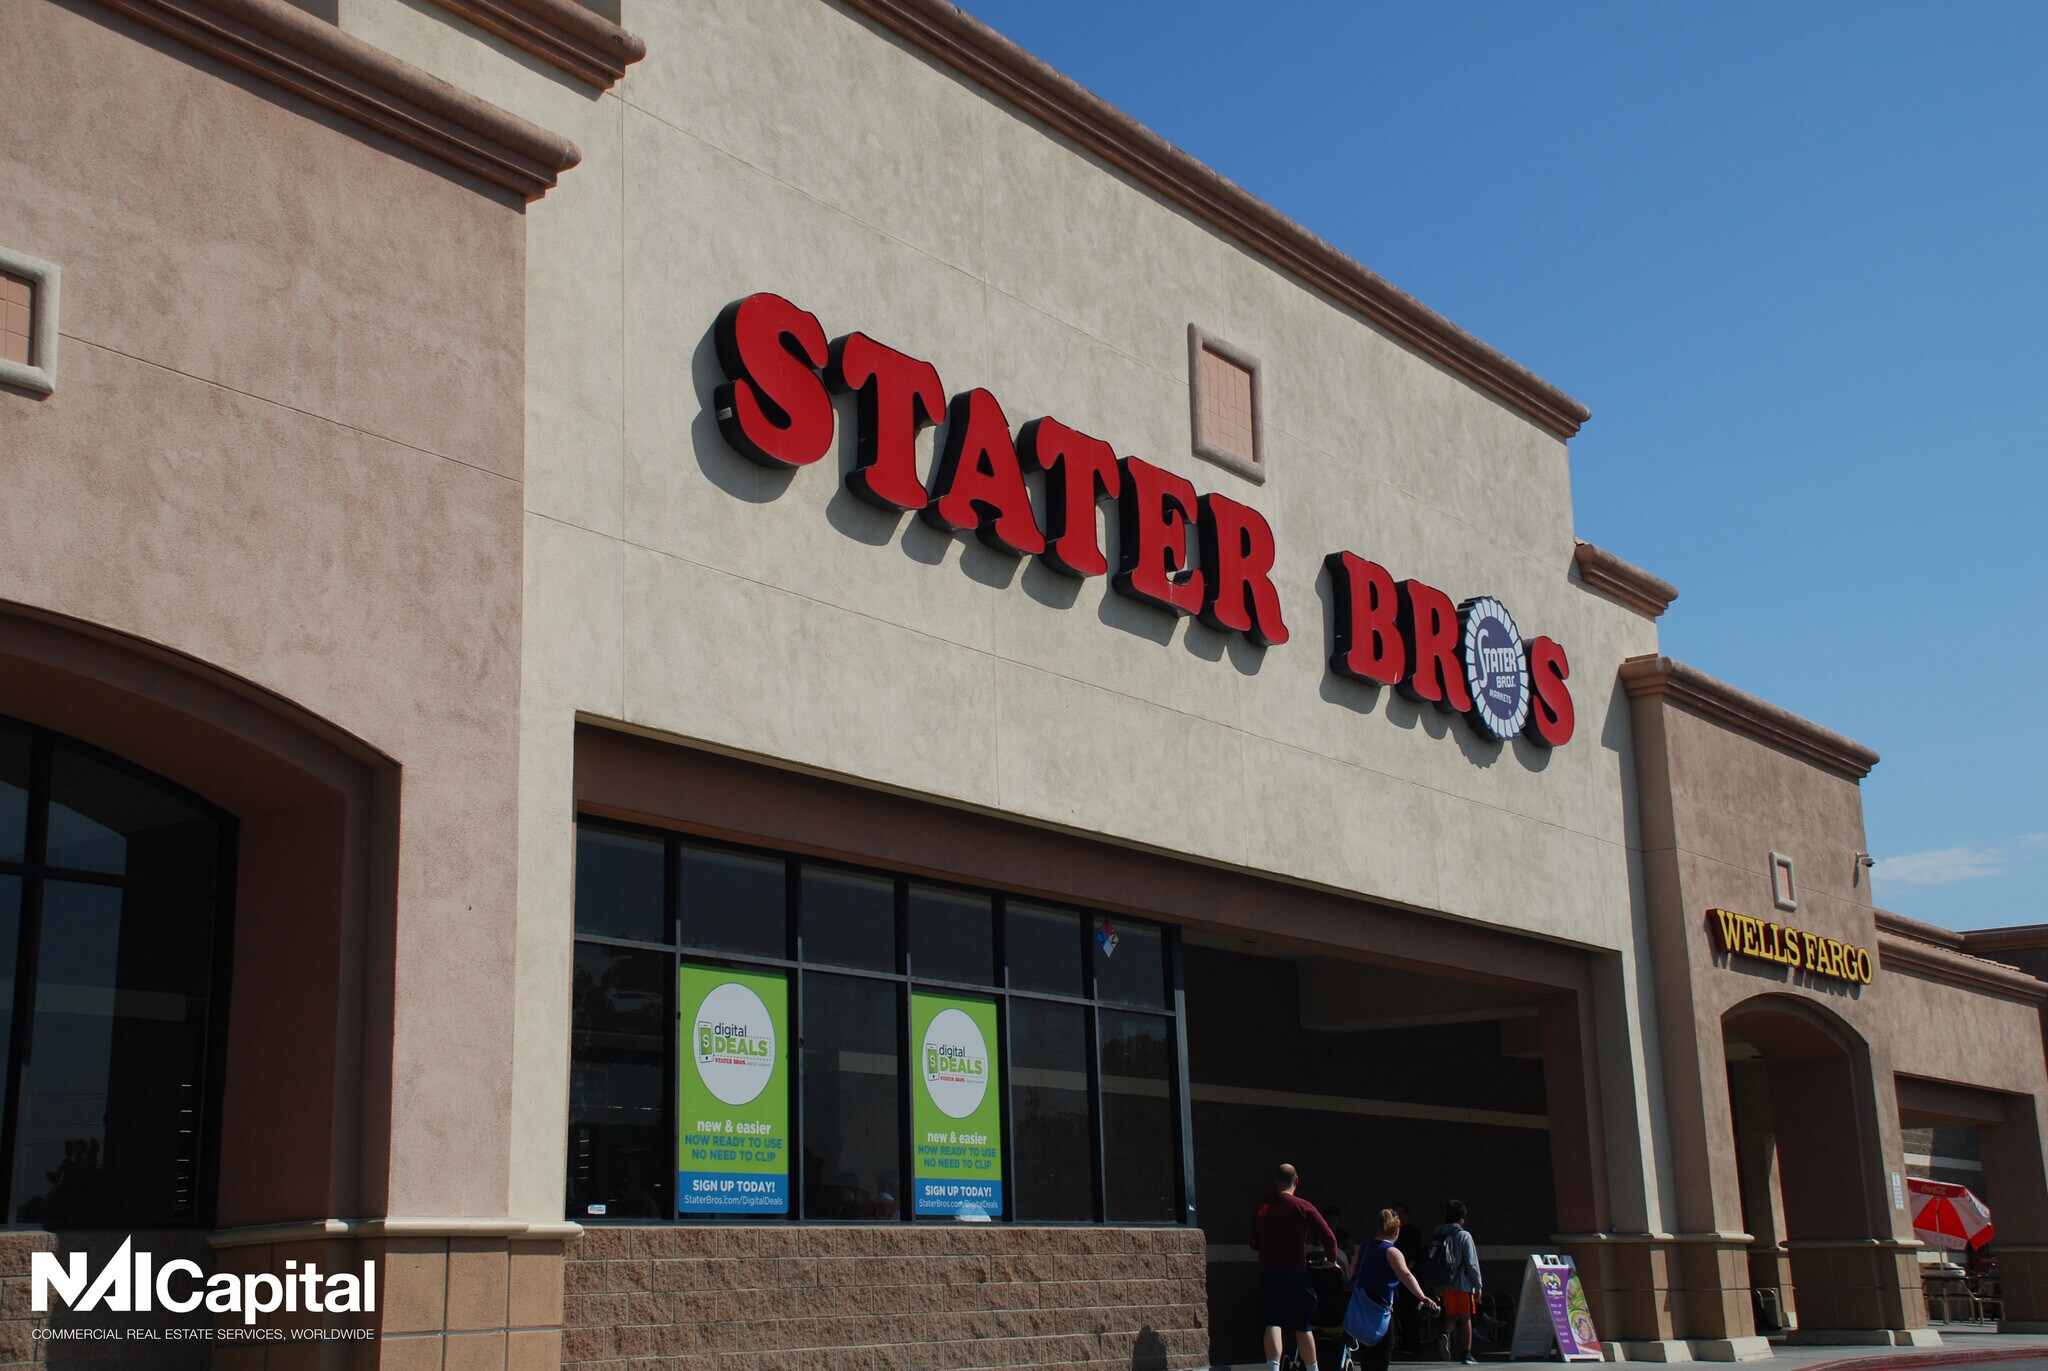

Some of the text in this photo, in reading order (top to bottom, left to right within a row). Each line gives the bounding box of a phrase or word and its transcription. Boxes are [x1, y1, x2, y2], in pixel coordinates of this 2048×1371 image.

[715, 292, 1290, 647] STATER
[1477, 628, 1517, 688] STATER
[1716, 908, 1873, 985] WELLS FARGO
[714, 1022, 747, 1039] digital
[714, 1036, 768, 1057] DEALS
[938, 1044, 966, 1059] digital
[940, 1057, 983, 1075] DEALS
[697, 1119, 772, 1135] new & easier
[684, 1134, 783, 1149] NOW READY TO USE
[927, 1131, 988, 1145] new & easier
[691, 1148, 776, 1163] NO NEED TO CLIP
[917, 1145, 997, 1158] NOW READY TO USE
[923, 1157, 992, 1170] NO NEED TO CLIP
[692, 1179, 776, 1193] SIGN UP TODAY!
[925, 1185, 992, 1197] SIGN UP TODAY!
[684, 1194, 783, 1207] StaterBros.com/DigitalDeals
